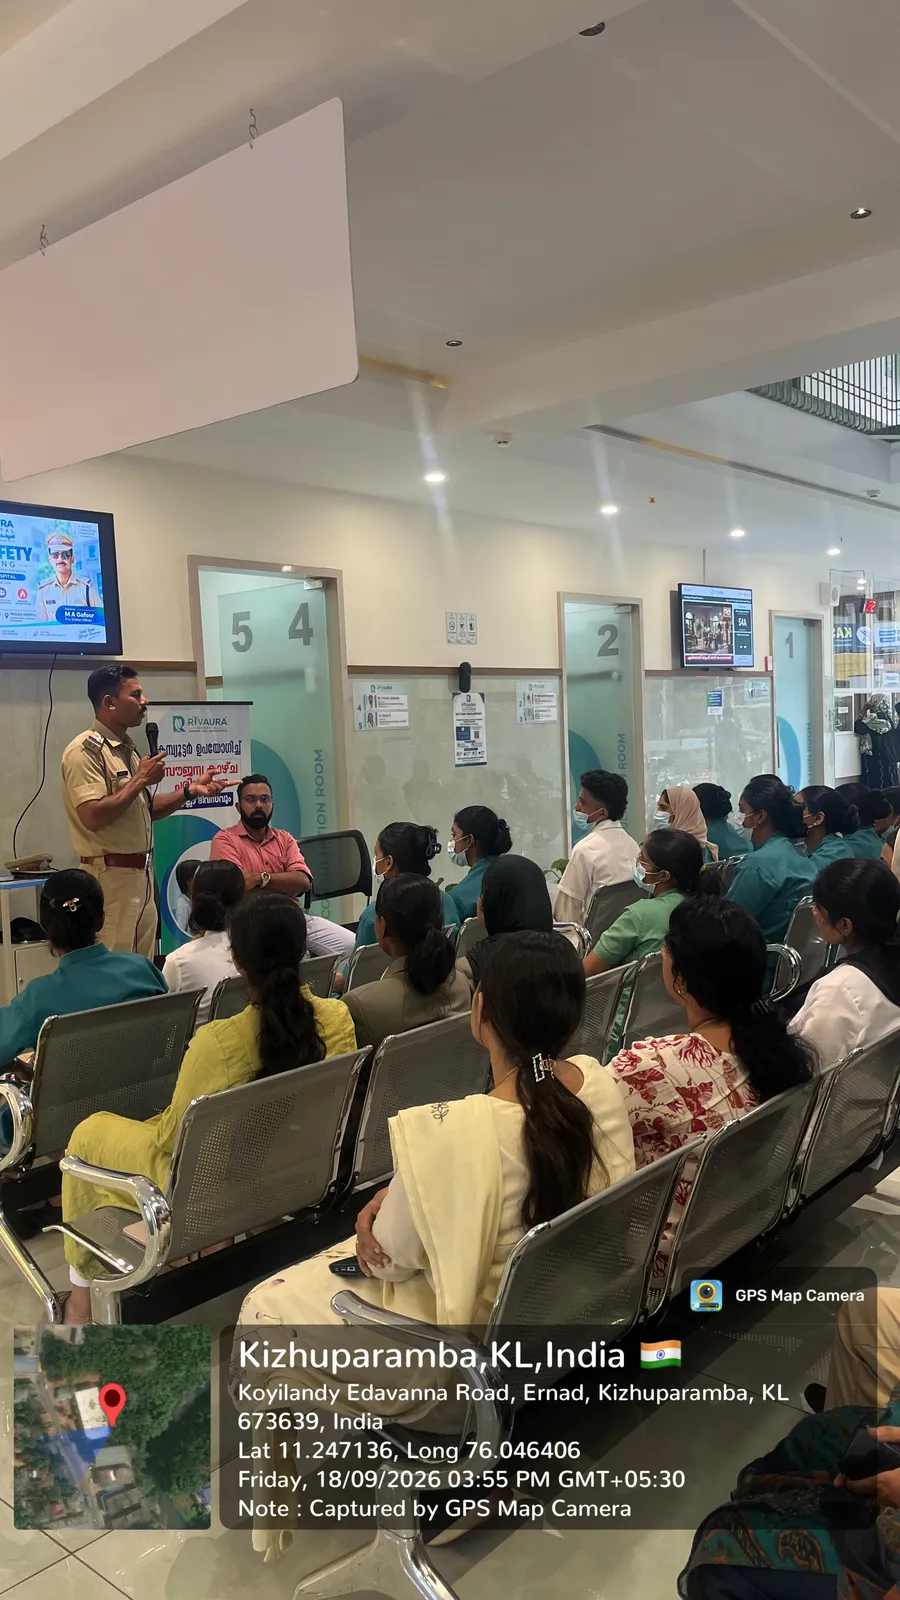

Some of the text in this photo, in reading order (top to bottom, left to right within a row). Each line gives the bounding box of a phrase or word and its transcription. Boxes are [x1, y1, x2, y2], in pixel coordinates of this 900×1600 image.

[231, 611, 254, 653] 5
[288, 602, 314, 647] 4
[597, 624, 619, 658] 2
[785, 631, 794, 659] 1
[187, 715, 228, 726] RIVAURA
[617, 733, 627, 770] ROOM
[313, 748, 325, 797] ROOM
